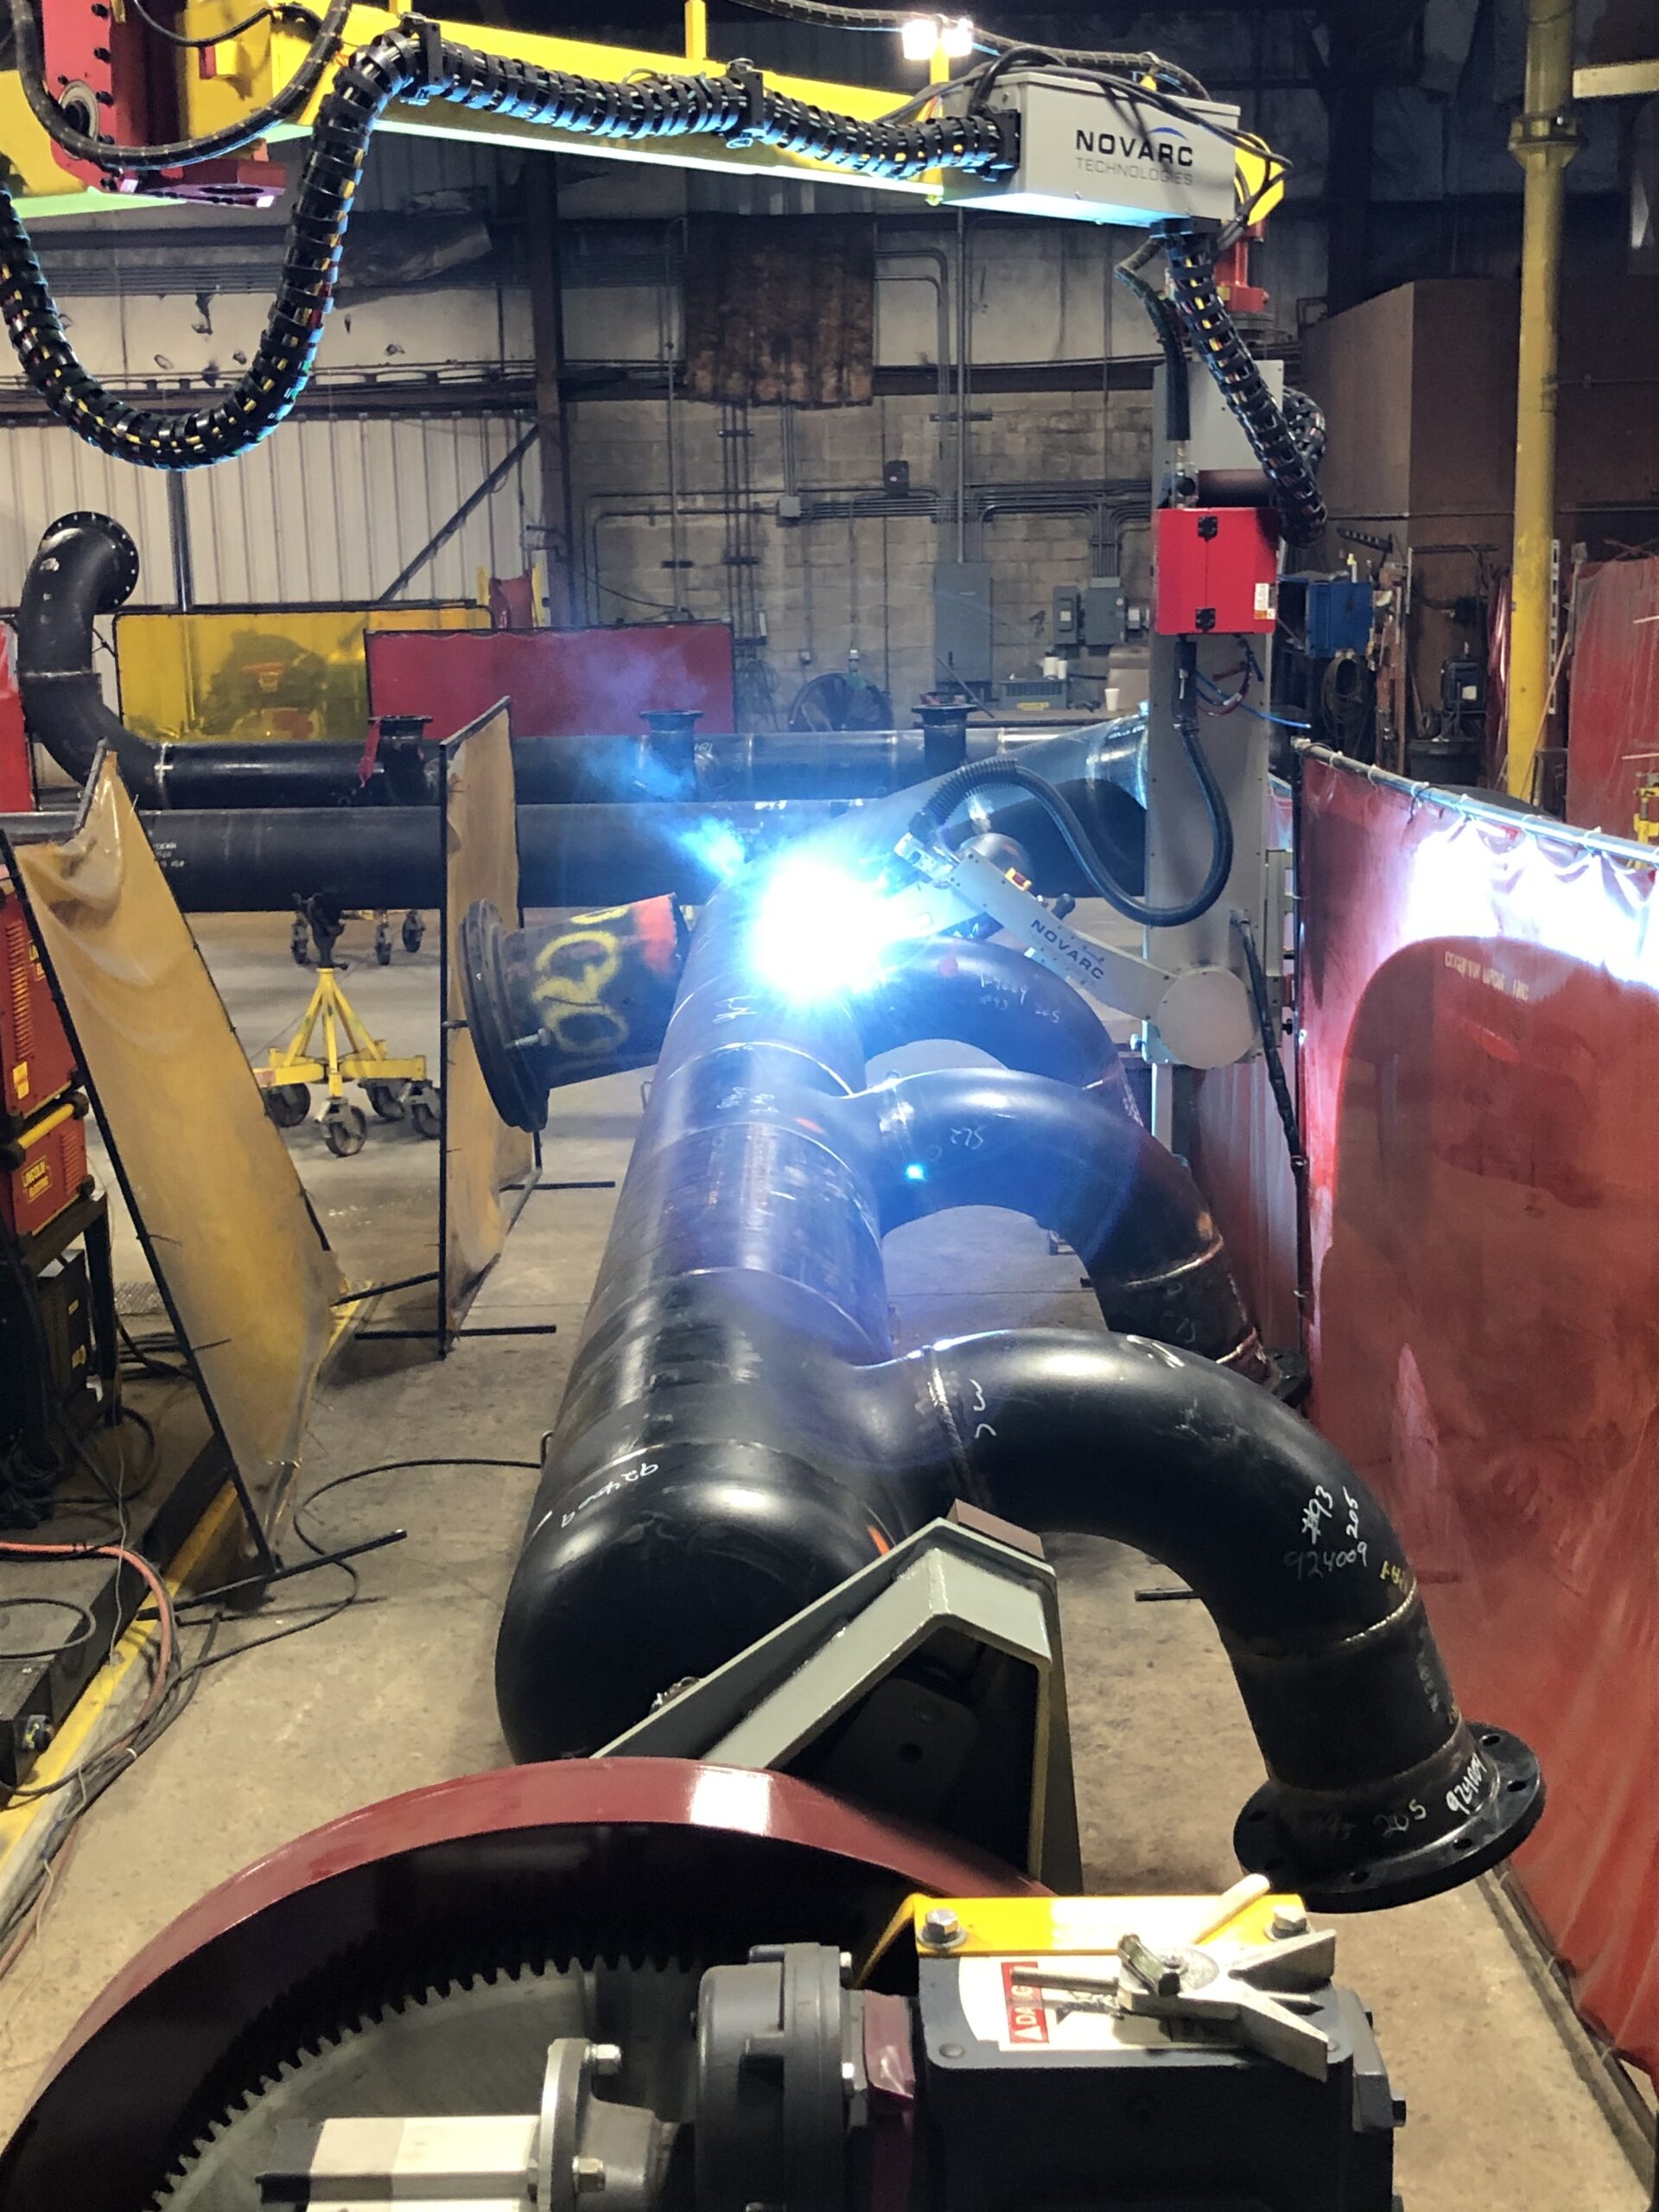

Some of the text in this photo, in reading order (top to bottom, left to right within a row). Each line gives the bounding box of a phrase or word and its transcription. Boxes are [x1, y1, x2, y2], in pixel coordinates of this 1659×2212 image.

[1076, 130, 1193, 167] NOVARC
[1031, 919, 1104, 979] NOVARC
[1342, 1485, 1359, 1539] 205
[1283, 1541, 1368, 1580] 924009
[1009, 1967, 1038, 2025] DAG
